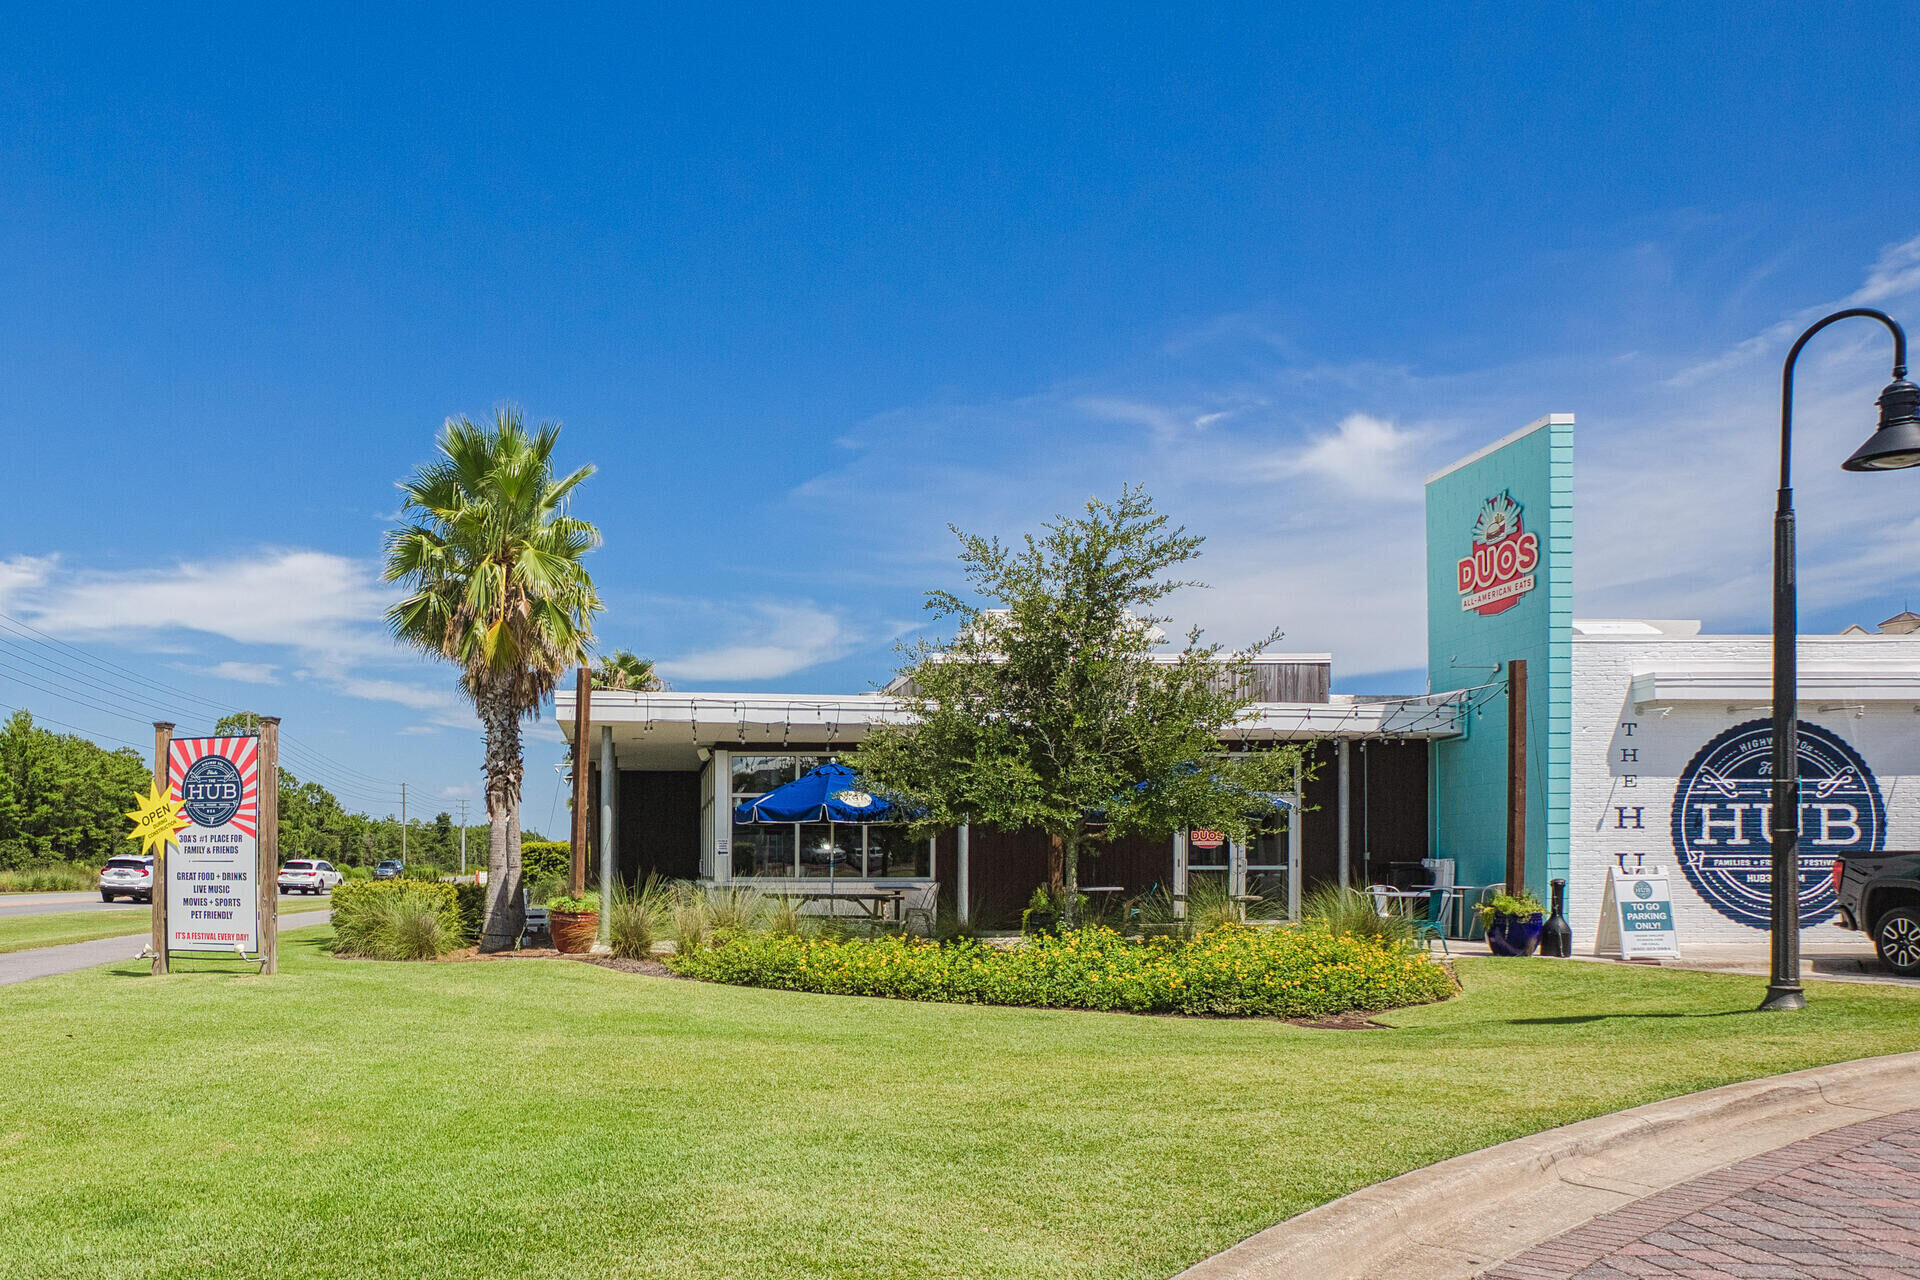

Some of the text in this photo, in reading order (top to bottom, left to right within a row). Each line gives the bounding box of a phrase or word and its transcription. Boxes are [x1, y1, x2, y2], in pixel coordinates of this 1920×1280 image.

[1458, 532, 1538, 595] DUOS
[1463, 578, 1531, 607] ALL-AMERICAN EATS
[1739, 737, 1773, 752] HIGHW
[1620, 722, 1639, 788] THE
[187, 784, 237, 800] HUB
[142, 803, 171, 826] OPEN
[153, 817, 168, 829] DURING
[1693, 803, 1862, 845] HUB
[148, 820, 177, 839] CONSTRUCTION
[179, 834, 243, 843] 30A'S #1 PLACE FOR
[1191, 830, 1224, 840] DUOS
[1614, 806, 1646, 875] HU
[184, 846, 239, 854] FAMILY & FRIENDS
[1713, 859, 1751, 867] FAMILIES
[176, 872, 197, 881] GREAT
[197, 872, 215, 881] FOOD
[222, 872, 247, 881] DRINKS
[193, 885, 230, 894] LIVE MUSIC
[183, 898, 208, 907] MOVIES
[214, 898, 241, 907] SPORTS
[1631, 903, 1660, 911] TO GO
[190, 910, 233, 920] PET FRIENDLY
[1626, 912, 1667, 920] PARKING
[1635, 922, 1661, 930] ONLY!
[175, 932, 249, 942] IT'S A FESTIVAL EVERY DAY!
